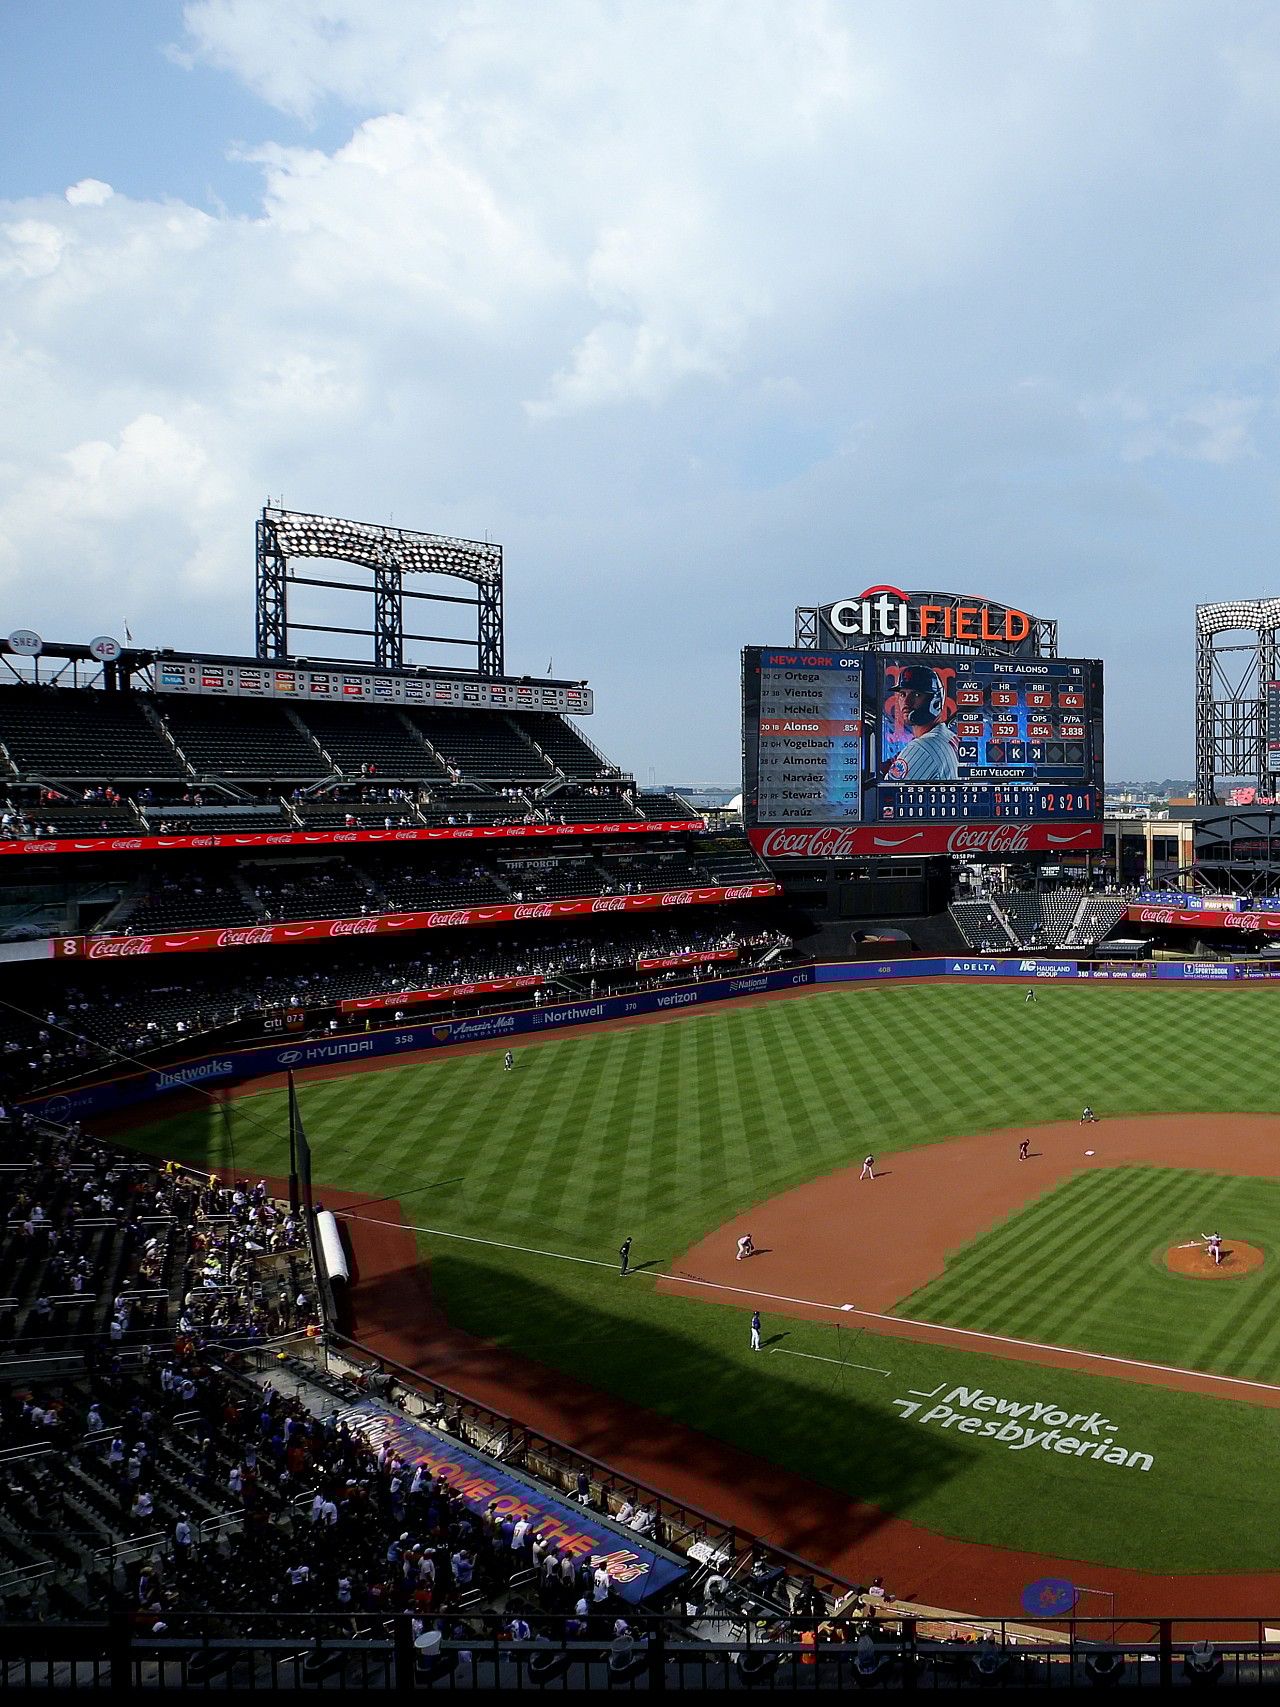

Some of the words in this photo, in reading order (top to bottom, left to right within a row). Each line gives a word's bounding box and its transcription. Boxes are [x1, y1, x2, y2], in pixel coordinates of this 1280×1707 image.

[830, 594, 908, 636] citi
[920, 605, 1030, 641] FIELD
[96, 642, 115, 655] 42
[769, 656, 798, 665] NEW
[800, 656, 833, 666] YORK
[839, 659, 860, 668] OPS
[959, 663, 970, 671] 20
[784, 671, 820, 682] Ortega
[784, 688, 823, 698] Vientos
[1032, 684, 1045, 692] RBI
[1068, 685, 1074, 693] R
[961, 694, 979, 702] .225
[999, 695, 1010, 703] 35
[1033, 696, 1044, 704] 87
[1065, 697, 1077, 705] 64
[784, 705, 820, 714] McNeil
[1031, 715, 1047, 723] OPS
[1063, 716, 1081, 724] P/PA
[783, 722, 819, 731] Alonso
[842, 724, 858, 732] .854
[961, 726, 979, 734] .325
[996, 726, 1014, 735] .529
[1030, 727, 1049, 735] .854
[1061, 727, 1083, 736] 3.838
[783, 739, 834, 750] Vogelbach
[959, 747, 977, 757] 0-2
[782, 756, 828, 765] Almonte
[782, 773, 825, 782] Narváez
[969, 769, 988, 777] EXIT
[988, 769, 1026, 777] VELOCITY
[782, 790, 822, 799] Stewart
[994, 793, 1002, 803] 13
[1256, 796, 1276, 804] new
[1041, 796, 1047, 809] B
[1047, 793, 1055, 811] 2
[1059, 796, 1065, 809] S
[1066, 793, 1073, 811] 2
[1084, 793, 1090, 811] 1
[781, 807, 812, 817] Araúz
[762, 826, 858, 857] Coca-Cola
[947, 824, 1034, 853] Coca-Cola
[505, 861, 525, 869] THE
[526, 859, 559, 868] PORCH
[724, 886, 754, 900] Coca-Cola
[591, 897, 628, 912] Coca-Cola
[427, 911, 471, 927] Coca-Cola
[1140, 908, 1175, 923] Coca-Cola
[1224, 913, 1261, 929] Coca-Cola
[329, 919, 379, 937] Coca-Cola
[217, 927, 275, 947] Coca-Cola
[63, 939, 78, 955] 8
[89, 937, 153, 959] Coca-Cola
[963, 962, 996, 972] DELTA
[1036, 965, 1070, 973] HAUGLAND
[1194, 967, 1228, 975] SPORTSBOOK
[738, 976, 768, 990] National
[792, 973, 808, 985] citi
[657, 991, 698, 1007] verizon
[625, 1002, 637, 1011] 370
[286, 1013, 305, 1023] 073
[544, 1005, 604, 1023] Northwell
[264, 1018, 282, 1029] citi
[452, 1019, 494, 1035] Amazin'
[493, 1016, 515, 1029] Mets
[454, 1026, 515, 1041] FOUNDATION
[394, 1034, 414, 1045] 358
[306, 1040, 374, 1059] HYUNDAI
[155, 1060, 233, 1088] Justworks
[919, 1404, 1155, 1472] Presbyterian
[417, 1455, 499, 1502] HOME
[491, 1494, 540, 1521] OF
[530, 1514, 600, 1558] THE
[590, 1549, 650, 1584] Mets
